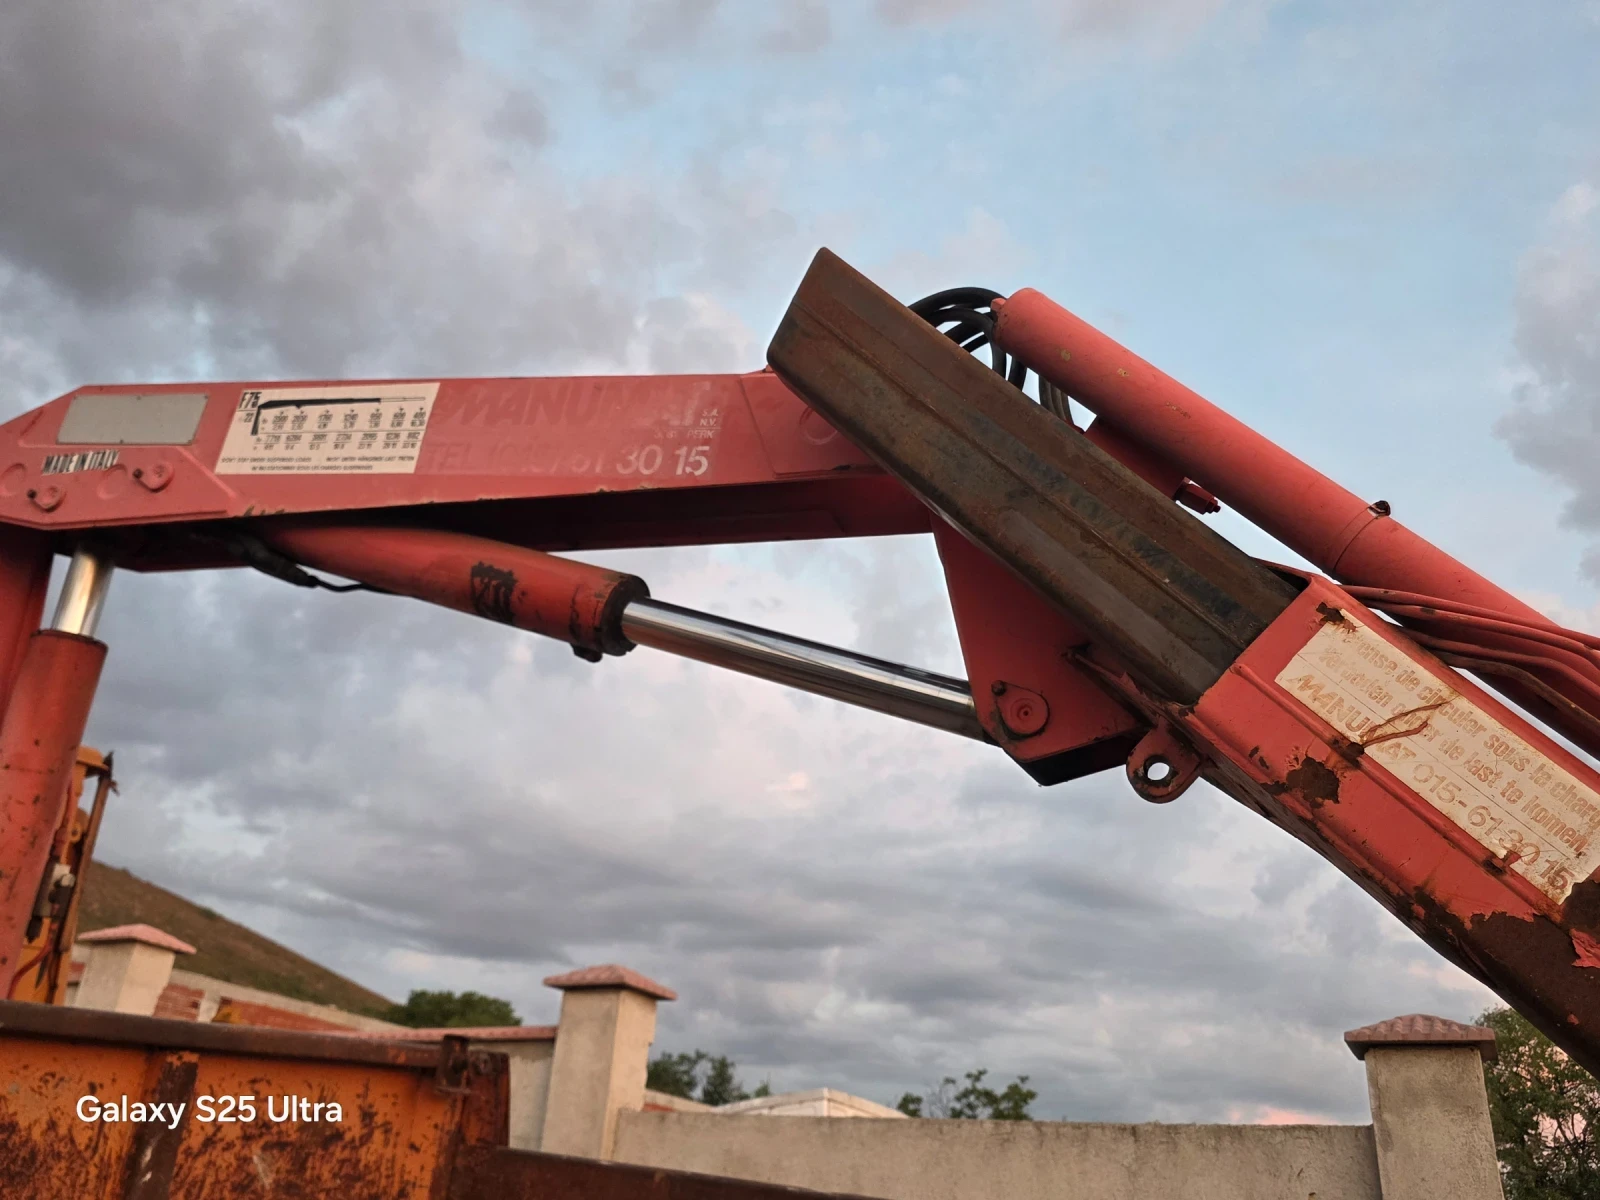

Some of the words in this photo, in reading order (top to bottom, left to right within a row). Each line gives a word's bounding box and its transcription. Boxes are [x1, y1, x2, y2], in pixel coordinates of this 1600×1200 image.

[239, 391, 262, 409] F75
[616, 445, 663, 476] 30
[675, 445, 710, 477] 15
[1394, 665, 1423, 693] de
[1482, 731, 1531, 774] sous
[1528, 761, 1555, 789] la
[1461, 749, 1505, 789] last
[1498, 777, 1527, 806] te
